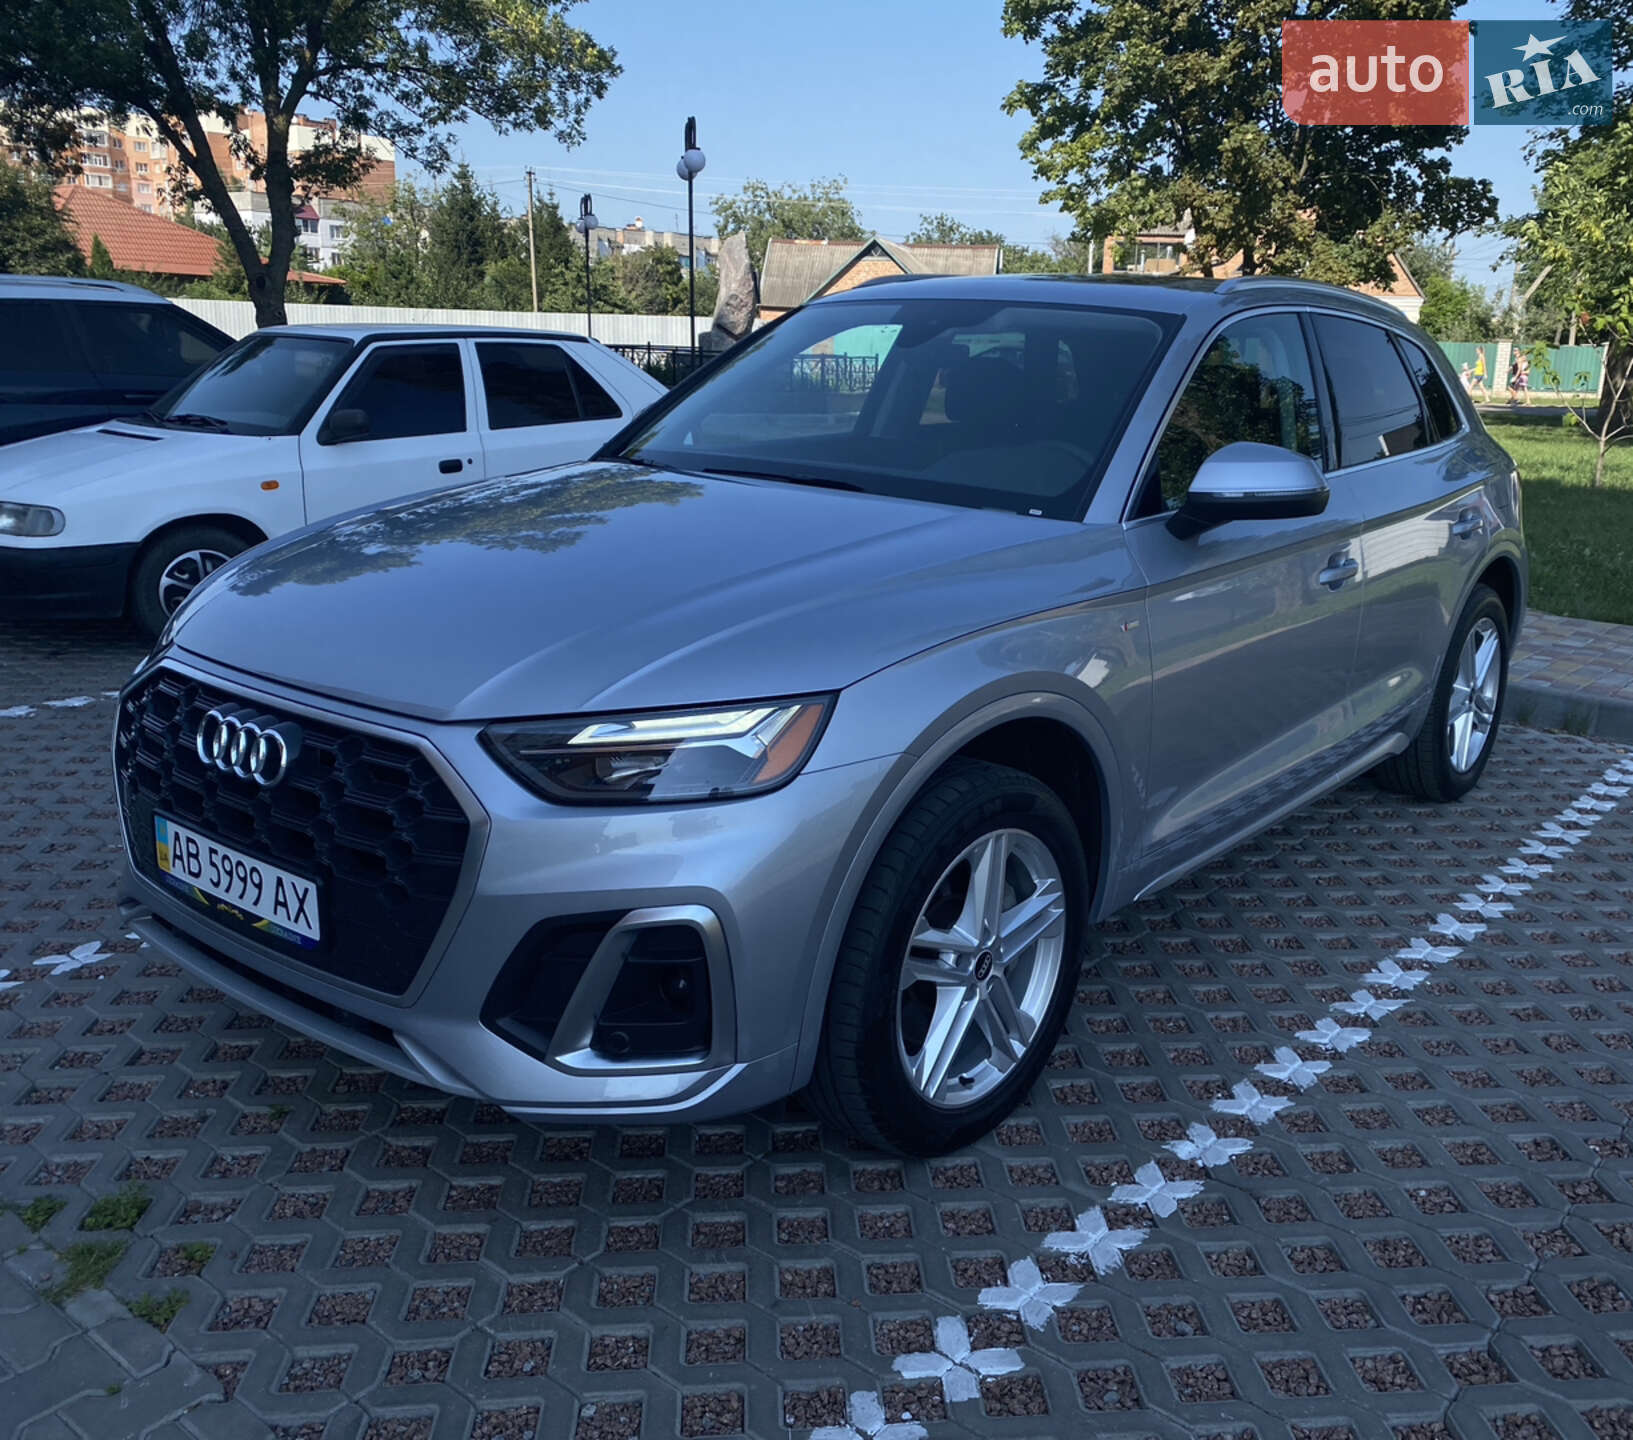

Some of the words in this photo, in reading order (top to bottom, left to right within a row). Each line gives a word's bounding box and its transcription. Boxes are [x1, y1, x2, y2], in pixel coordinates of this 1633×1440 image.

[172, 831, 202, 879] AB
[208, 846, 264, 907] 5999
[273, 875, 313, 931] AX
